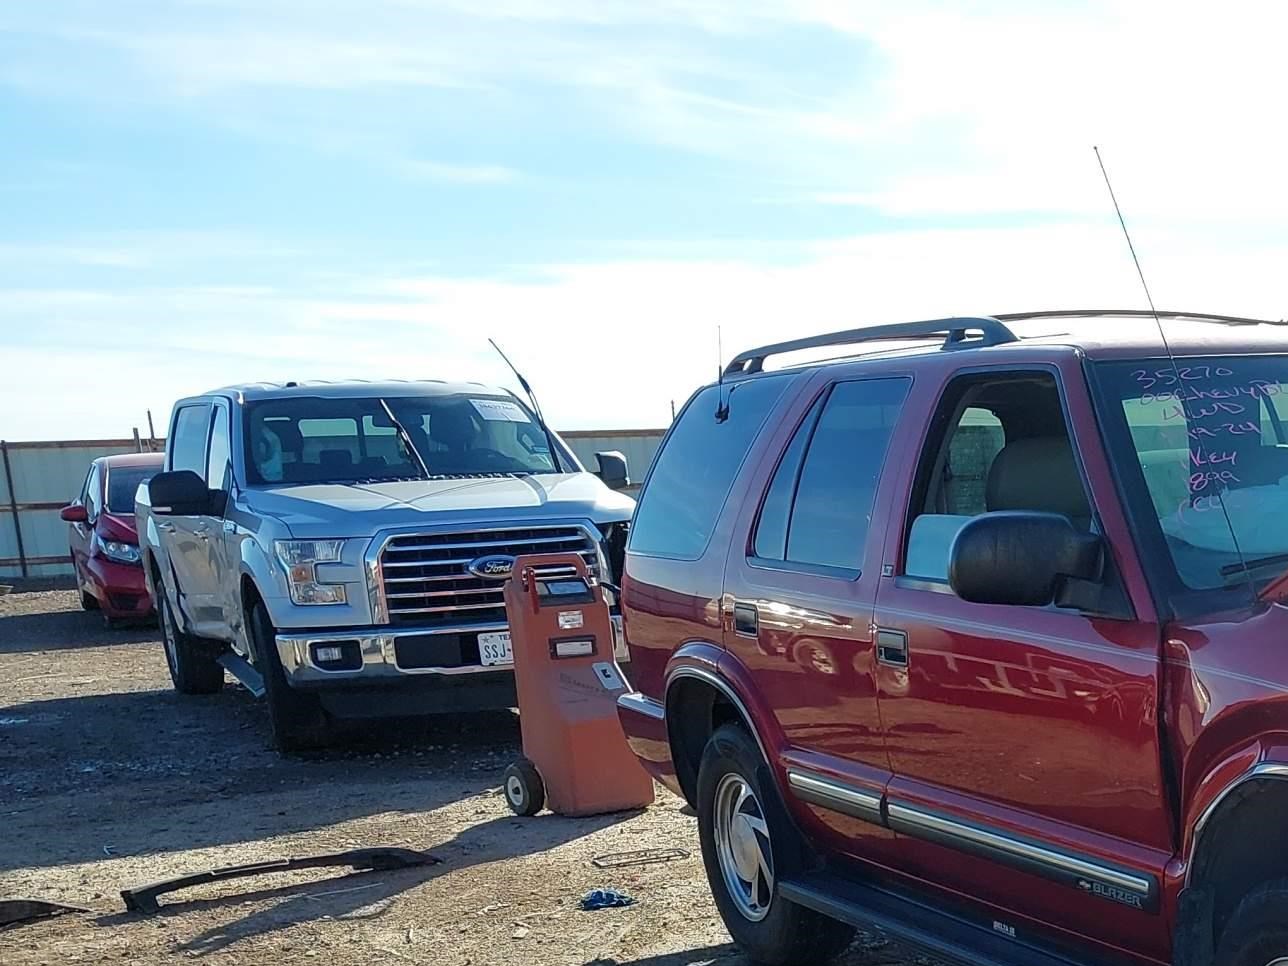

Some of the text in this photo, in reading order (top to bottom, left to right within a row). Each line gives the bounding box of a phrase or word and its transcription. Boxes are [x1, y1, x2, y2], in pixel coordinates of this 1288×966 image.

[1131, 366, 1233, 389] 35270
[484, 561, 511, 574] Ford
[1092, 881, 1143, 909] BLAZER
